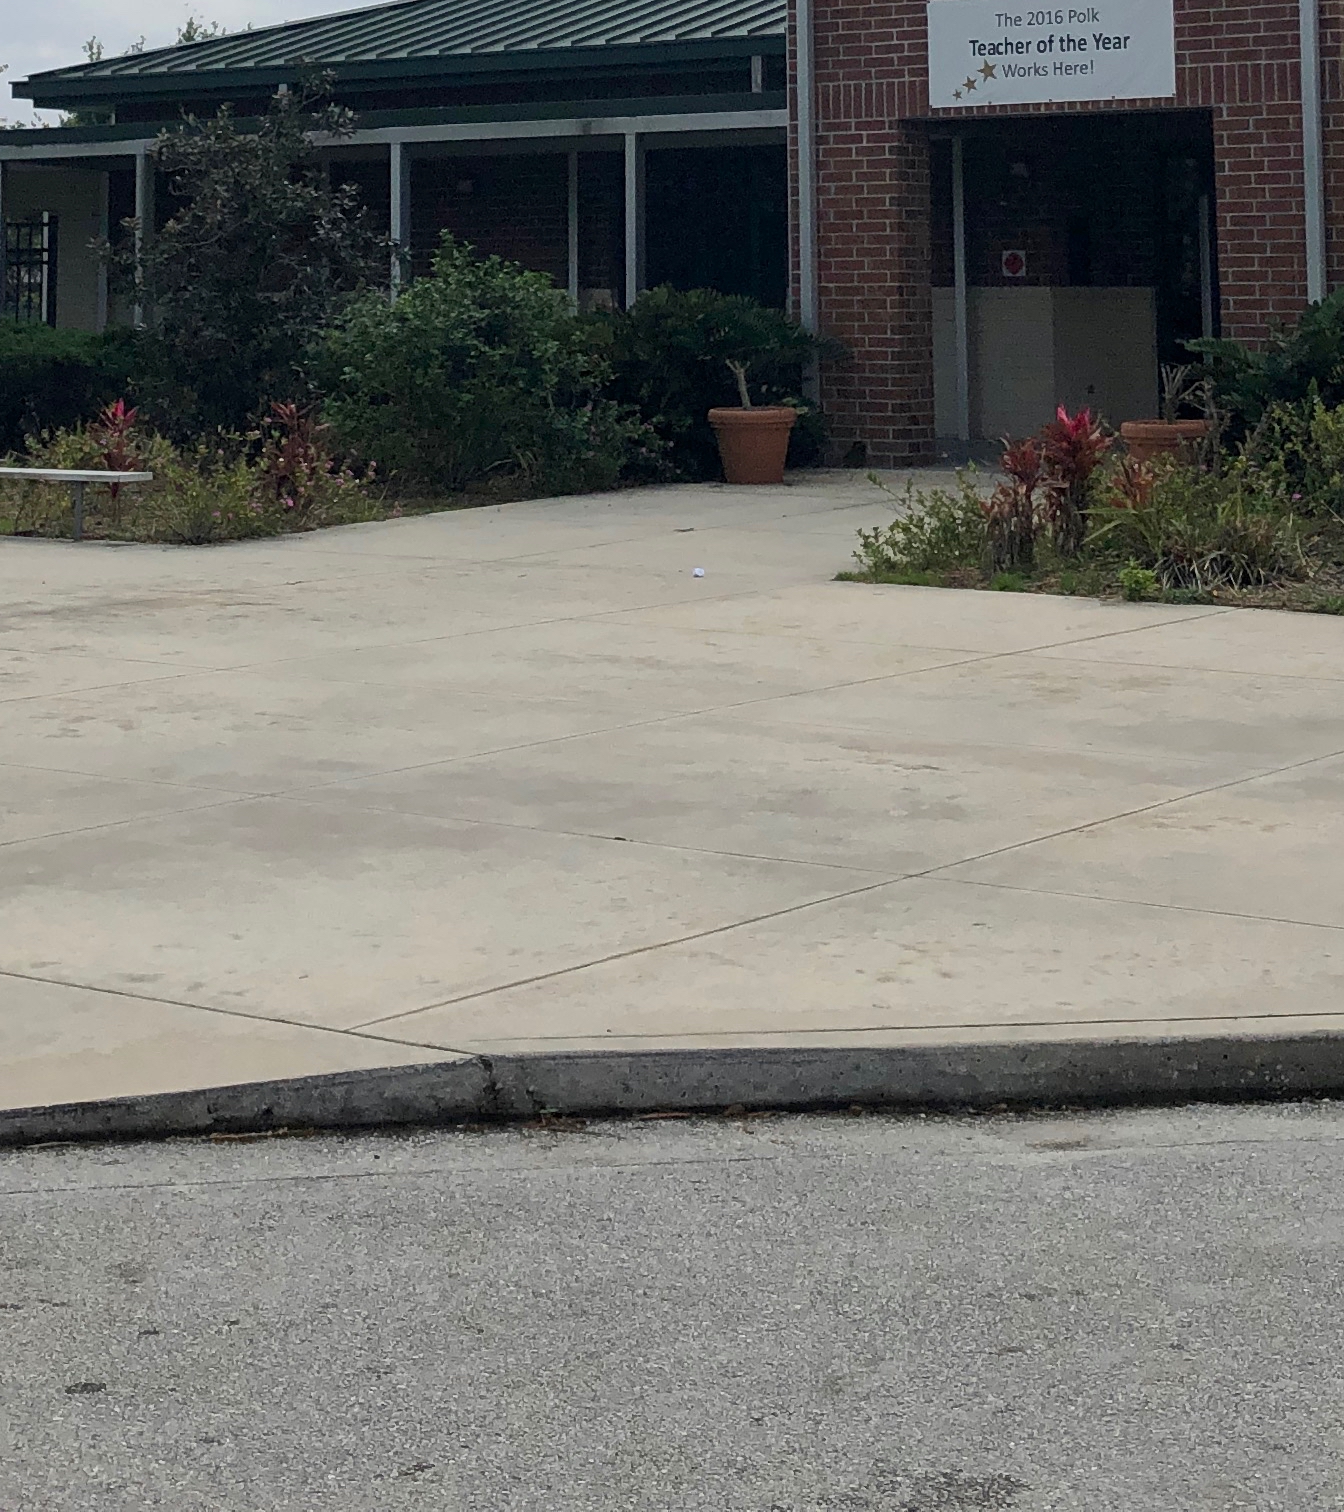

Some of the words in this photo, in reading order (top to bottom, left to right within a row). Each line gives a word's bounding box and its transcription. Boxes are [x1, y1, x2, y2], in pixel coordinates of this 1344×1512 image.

[995, 13, 1022, 28] The
[1027, 10, 1064, 26] 2016
[1068, 7, 1100, 23] Polk
[969, 37, 1032, 57] Teacher
[1036, 35, 1055, 54] of
[1059, 34, 1088, 52] the
[1092, 33, 1131, 51] Year
[1002, 61, 1049, 78] Works
[1053, 59, 1094, 76] Here!
